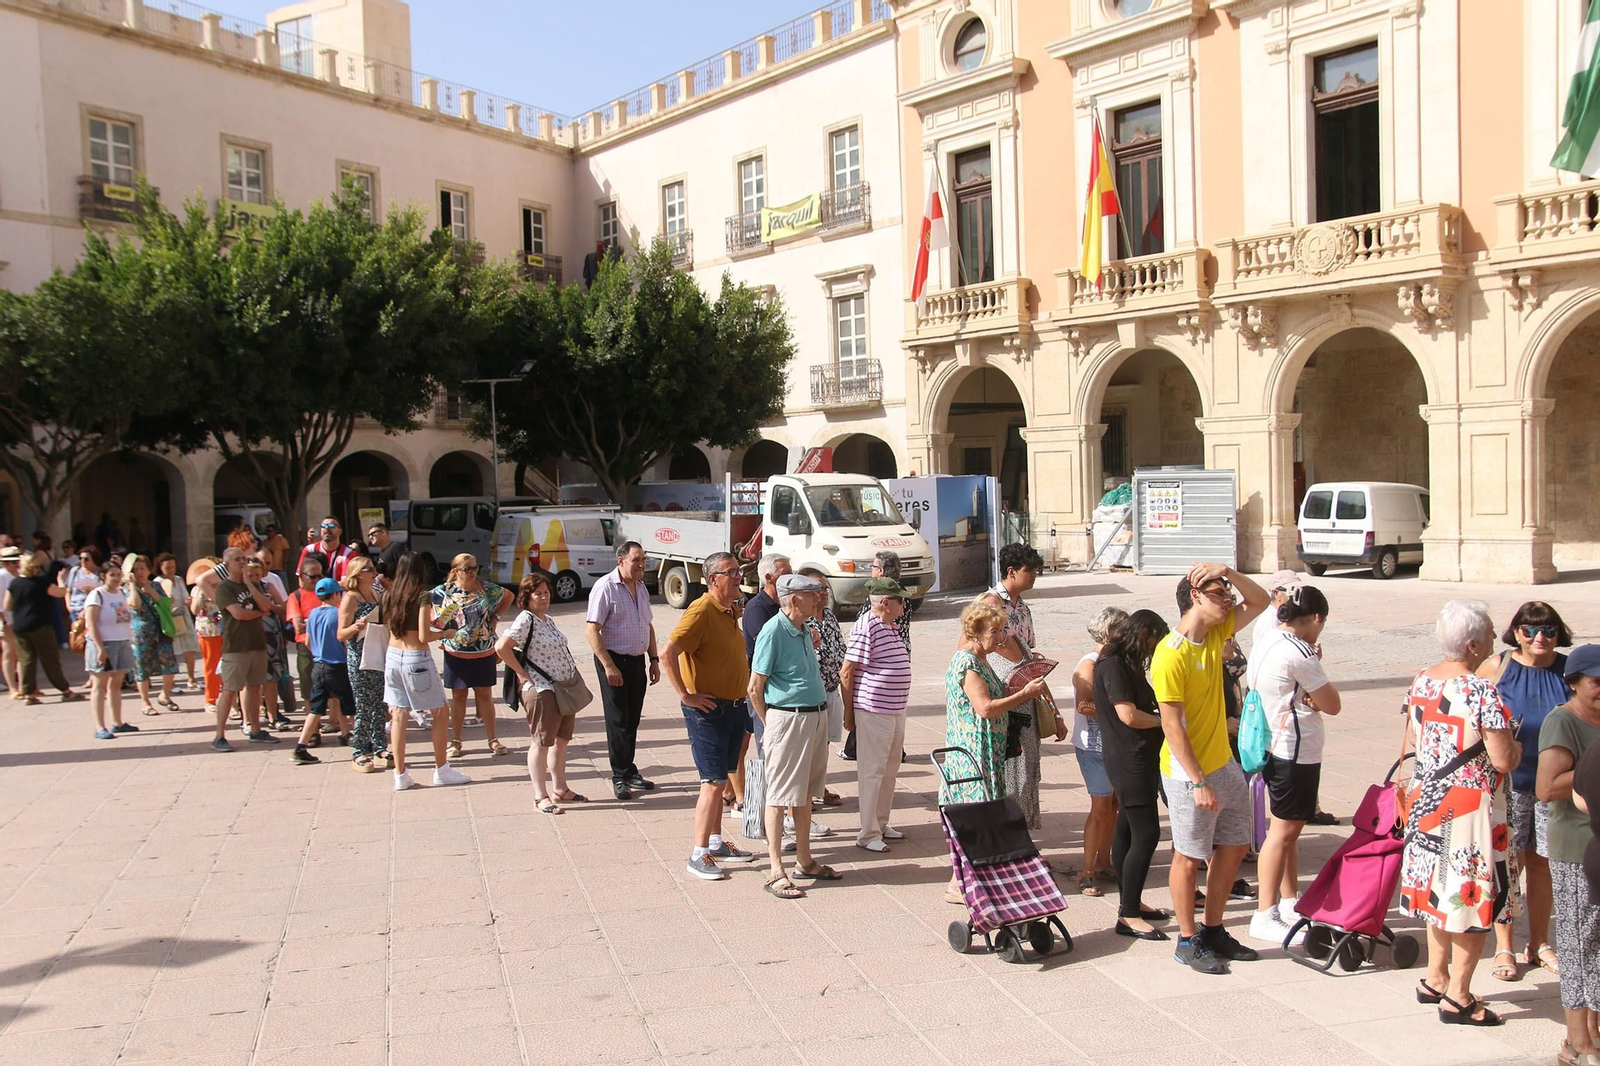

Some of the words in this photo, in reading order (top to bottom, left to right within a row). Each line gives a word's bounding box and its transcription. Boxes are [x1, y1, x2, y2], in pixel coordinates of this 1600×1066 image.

[901, 488, 913, 499] tu
[655, 529, 680, 541] STAND
[873, 537, 912, 547] STAND
